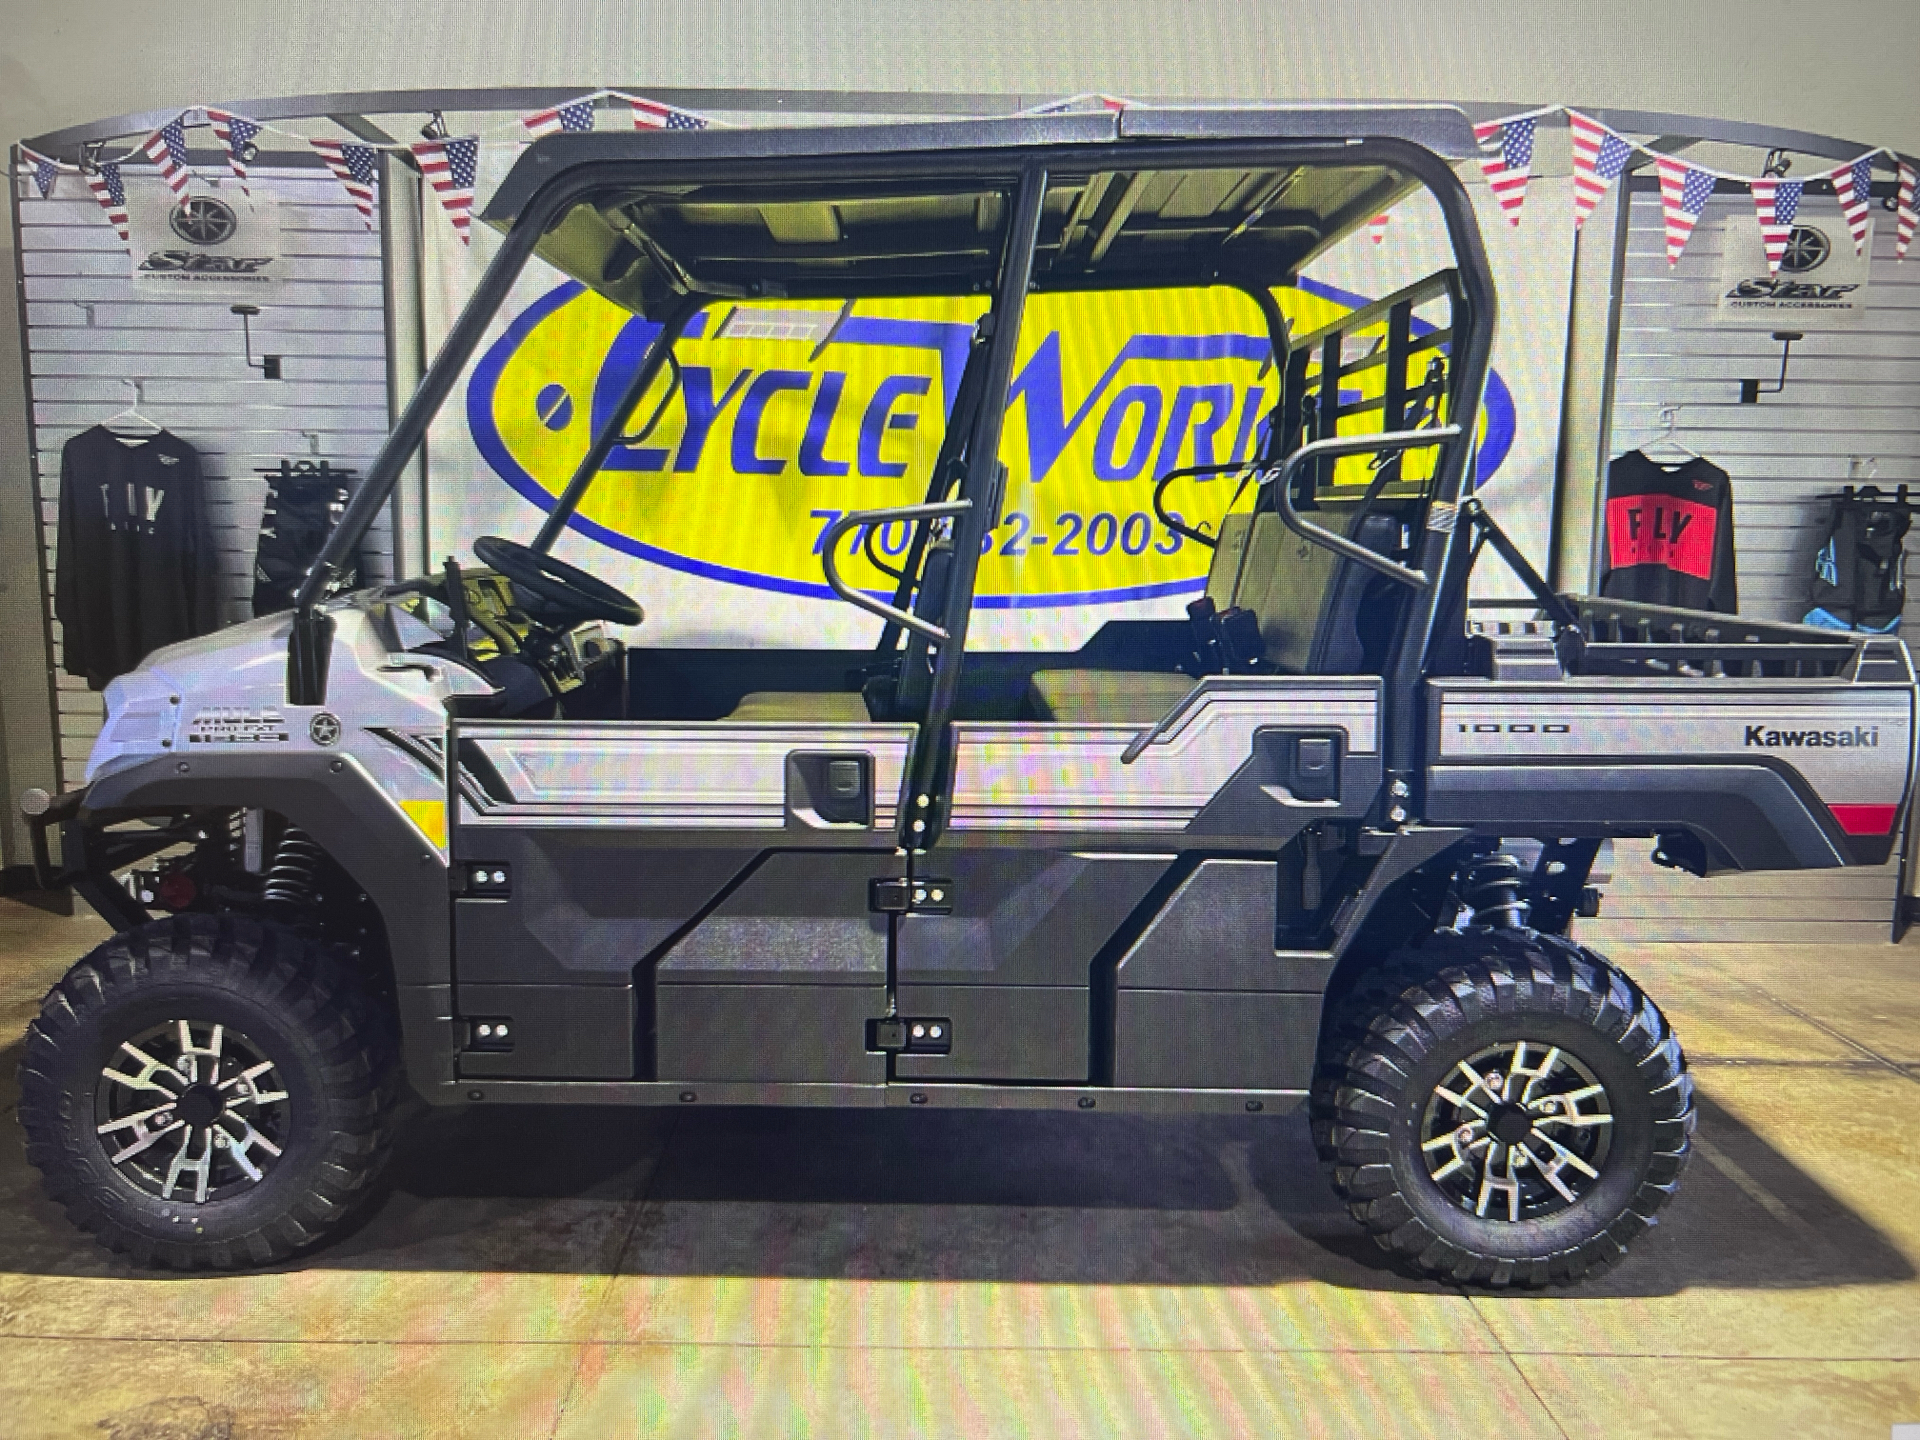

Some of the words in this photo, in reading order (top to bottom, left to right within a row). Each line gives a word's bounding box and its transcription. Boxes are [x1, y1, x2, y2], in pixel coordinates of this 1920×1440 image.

[1730, 301, 1776, 309] CUSTOM
[589, 312, 932, 478] CYCLE
[1628, 507, 1693, 544] FLY
[1458, 723, 1570, 733] 1000
[1745, 725, 1879, 747] Kawasaki
